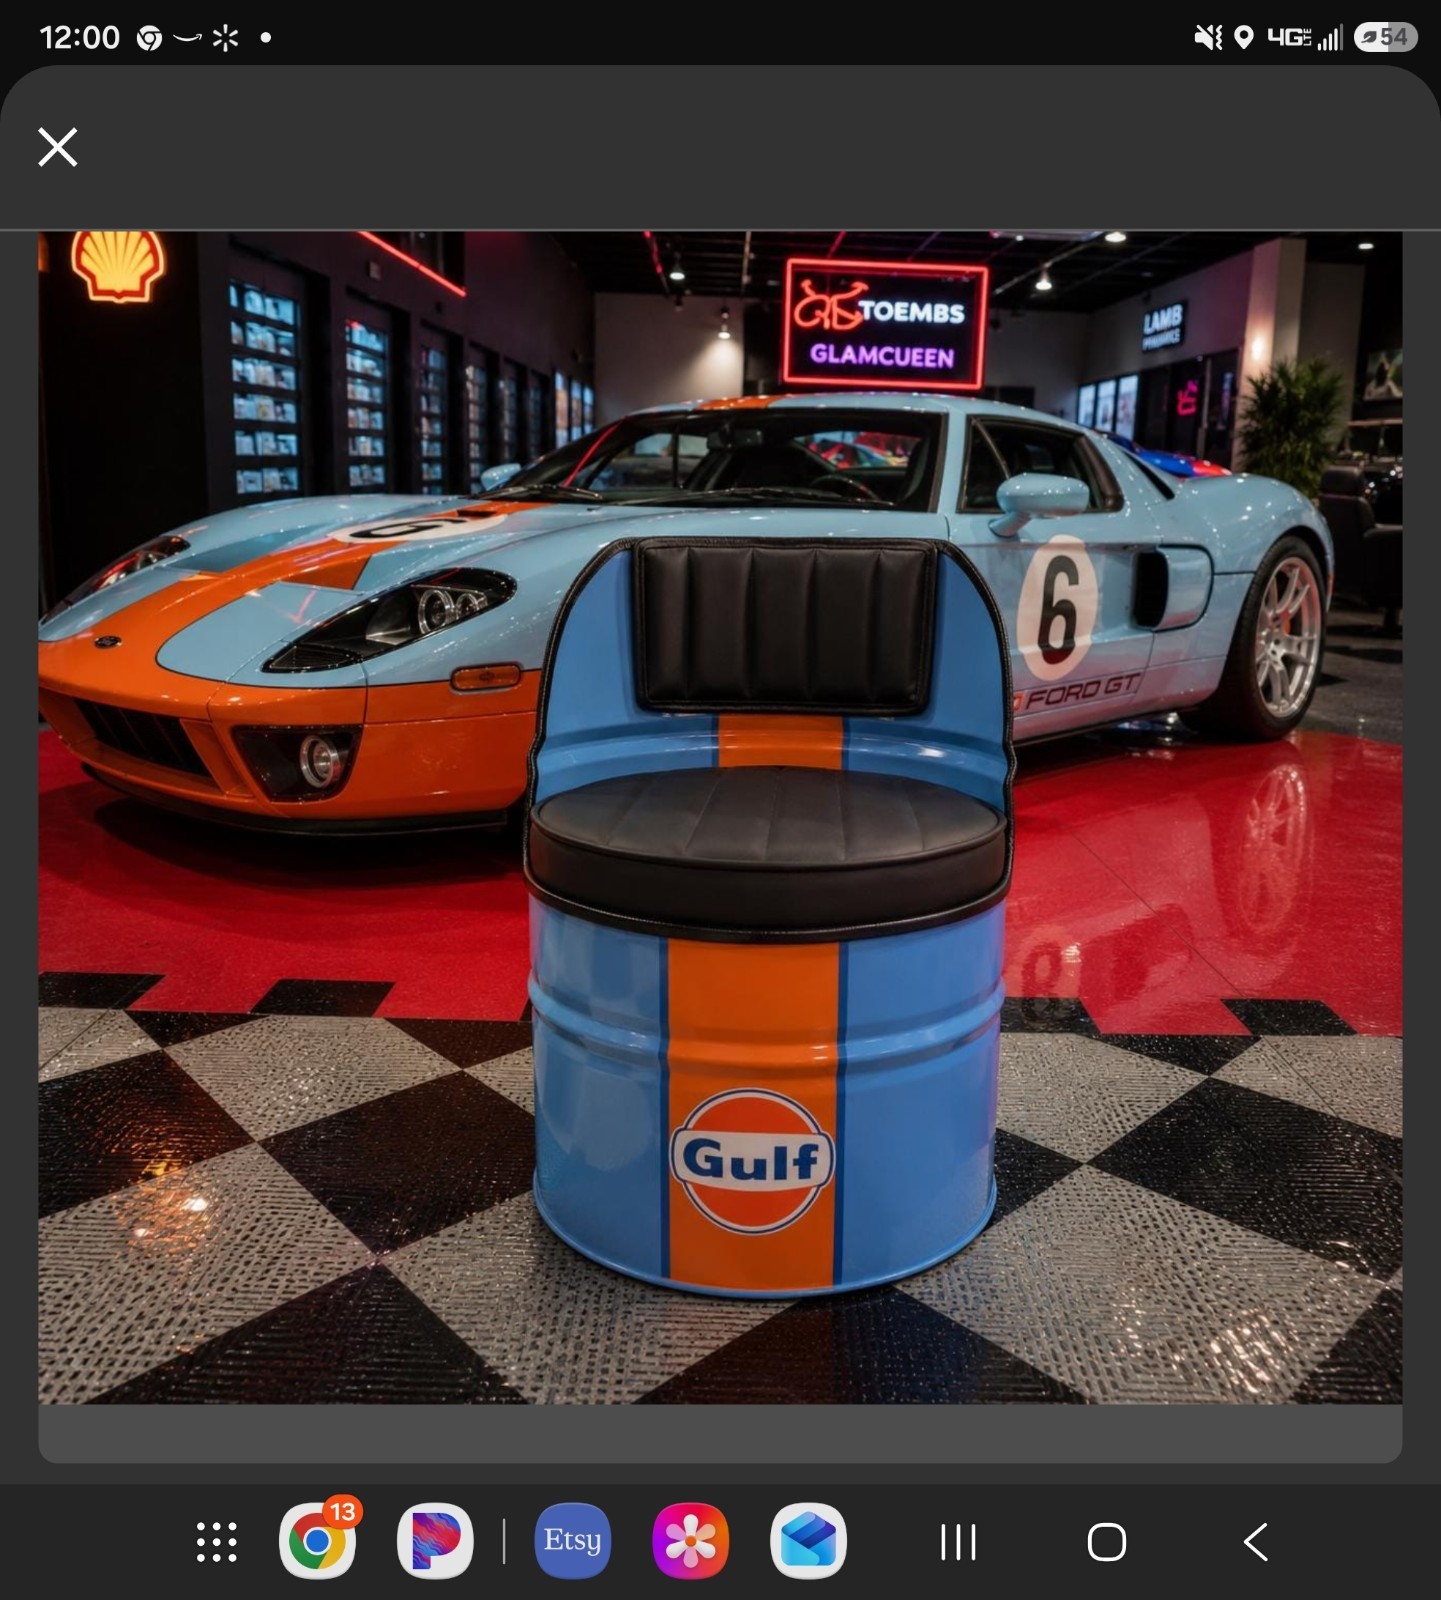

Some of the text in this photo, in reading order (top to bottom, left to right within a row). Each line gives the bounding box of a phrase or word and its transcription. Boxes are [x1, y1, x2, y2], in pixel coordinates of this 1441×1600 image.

[857, 299, 965, 324] TOEMBS
[1143, 304, 1183, 335] LAMB
[809, 343, 955, 369] GLAMCUEEN
[1037, 554, 1080, 665] 6
[1025, 673, 1141, 709] FORD GT
[683, 1138, 819, 1180] Gulf
